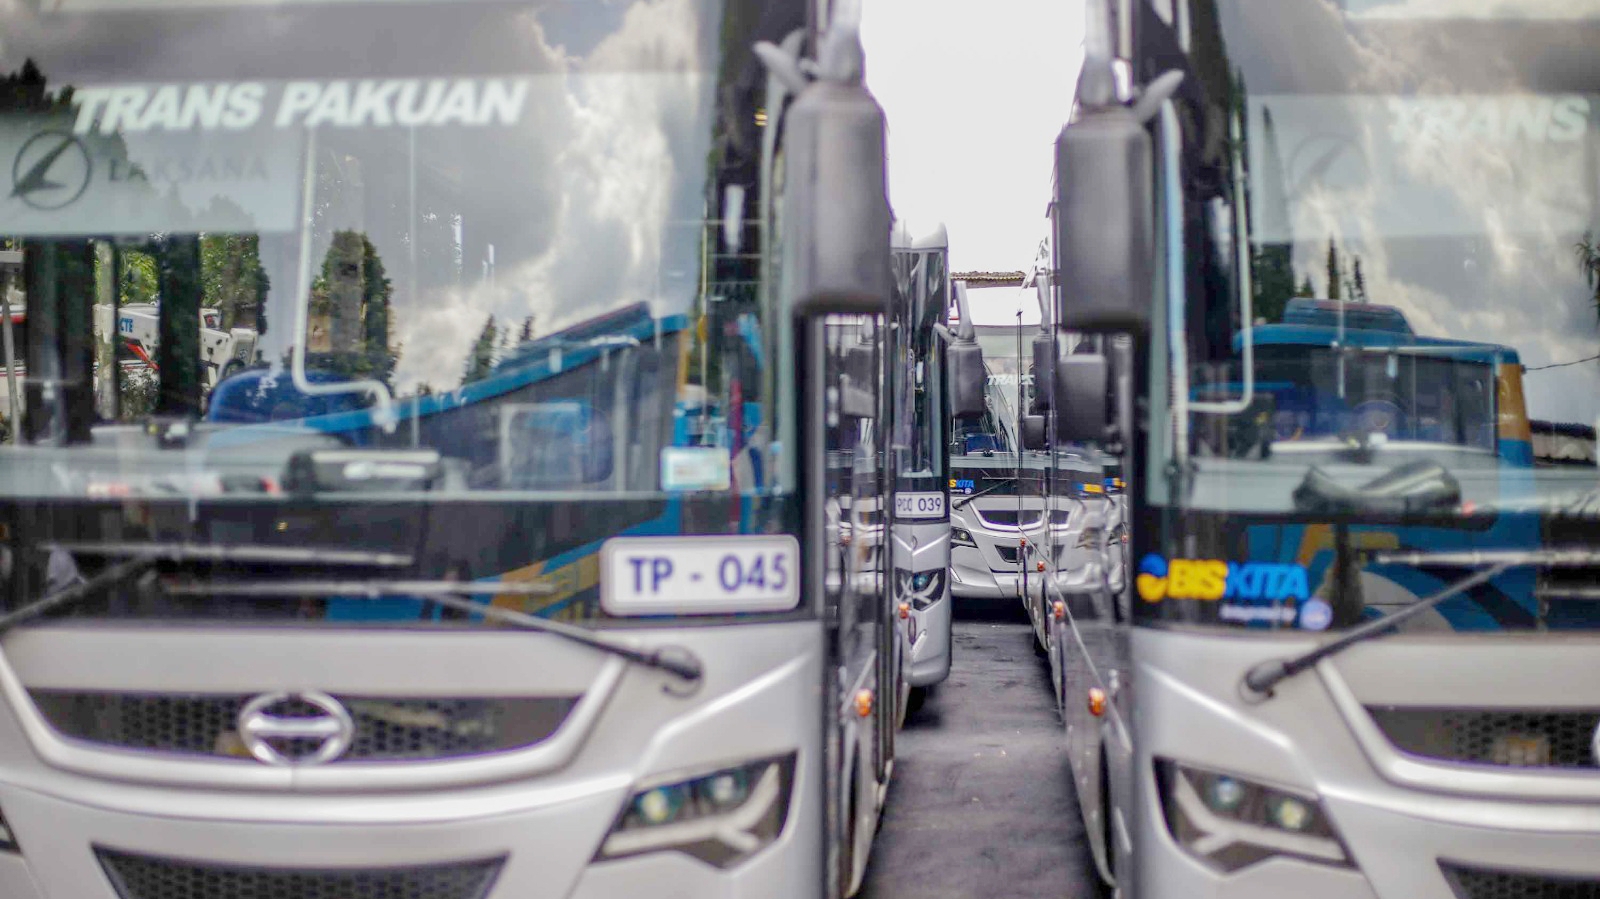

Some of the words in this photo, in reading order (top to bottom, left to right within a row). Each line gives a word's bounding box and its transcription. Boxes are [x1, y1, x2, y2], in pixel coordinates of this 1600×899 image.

[74, 81, 267, 132] TRANS
[275, 79, 528, 128] PAKUAN
[1388, 94, 1590, 143] TRANS
[918, 497, 942, 511] 039
[628, 555, 674, 595] TP
[718, 552, 788, 592] 045
[1166, 558, 1309, 600] BISKITA
